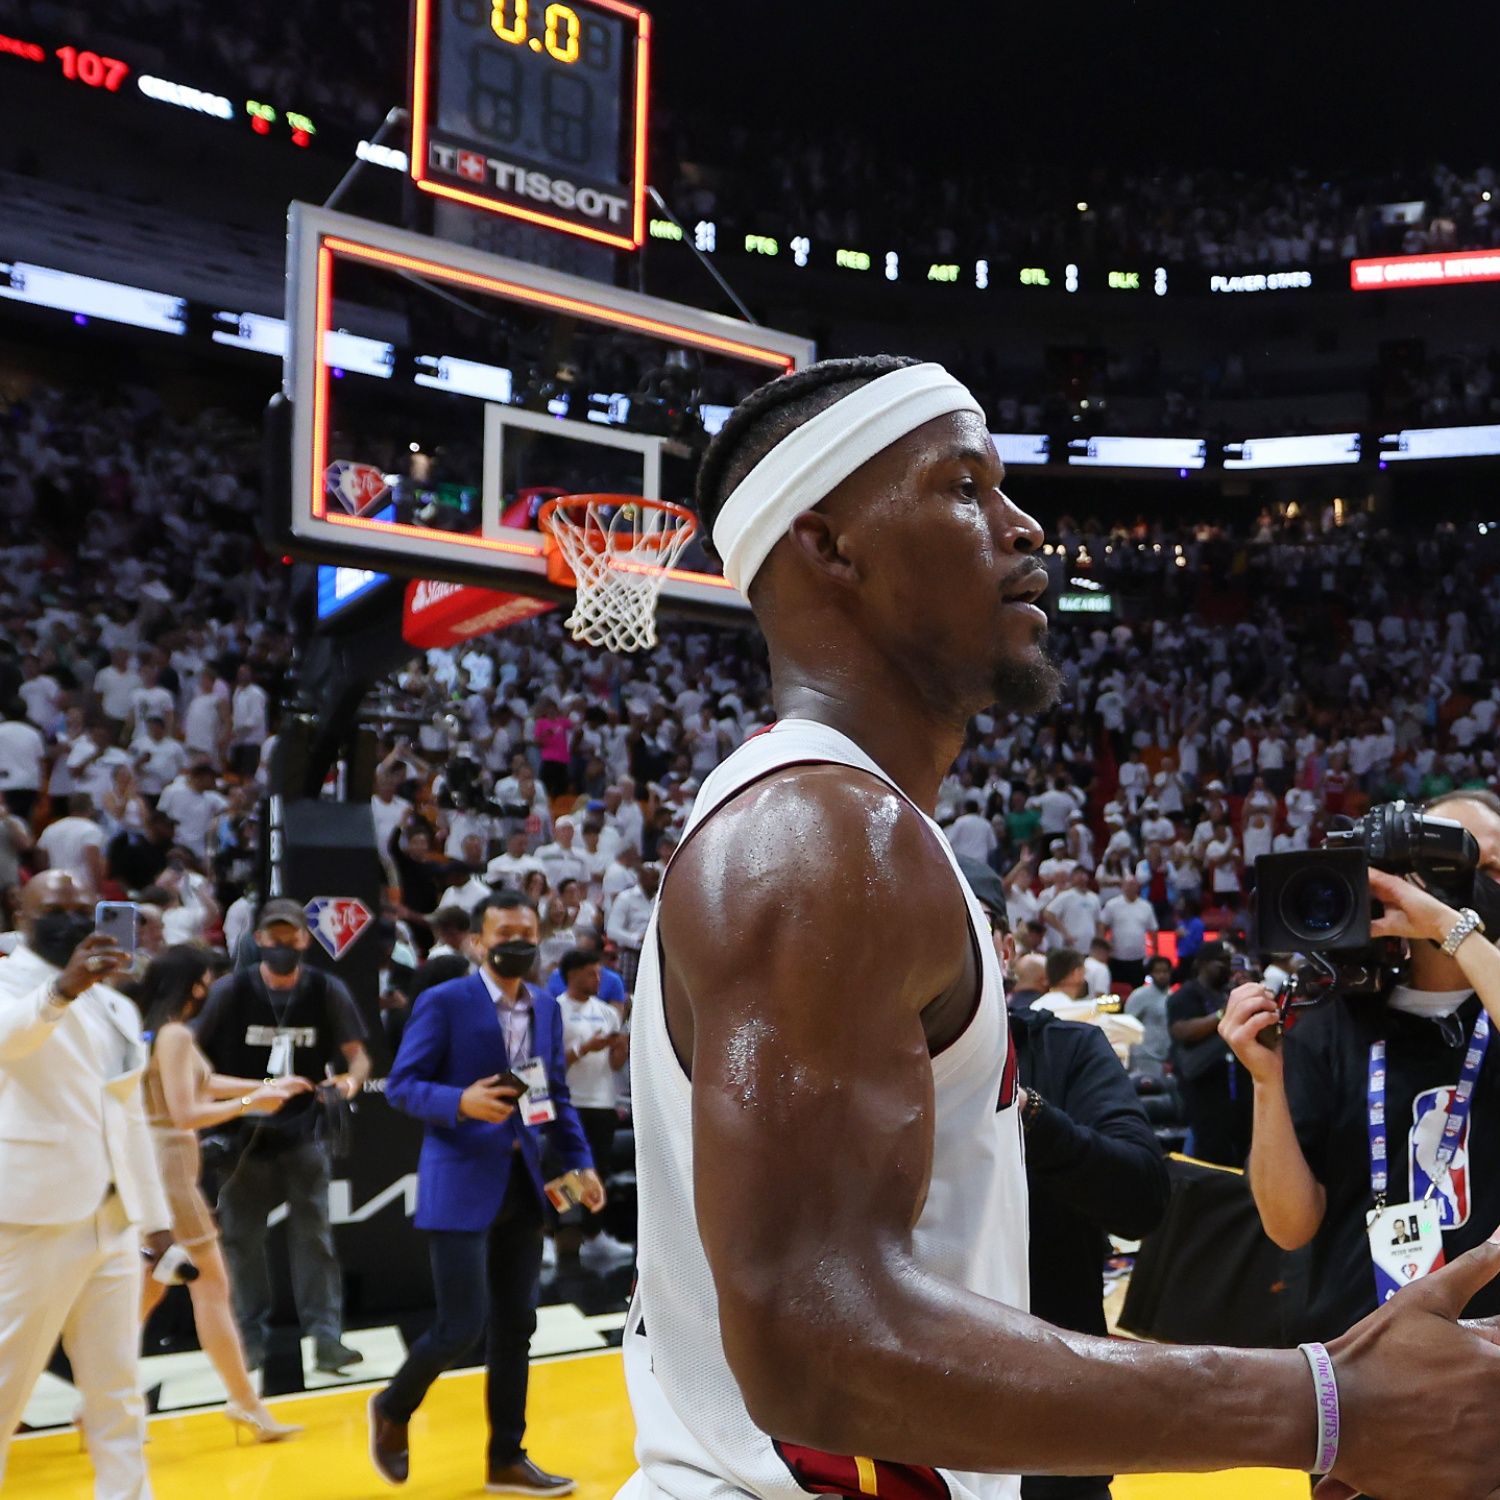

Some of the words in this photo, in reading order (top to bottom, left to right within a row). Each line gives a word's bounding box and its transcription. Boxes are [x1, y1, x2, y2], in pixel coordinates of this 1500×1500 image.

[55, 45, 129, 92] 107
[486, 158, 628, 223] TISSOT
[1210, 274, 1267, 293] PLAYER
